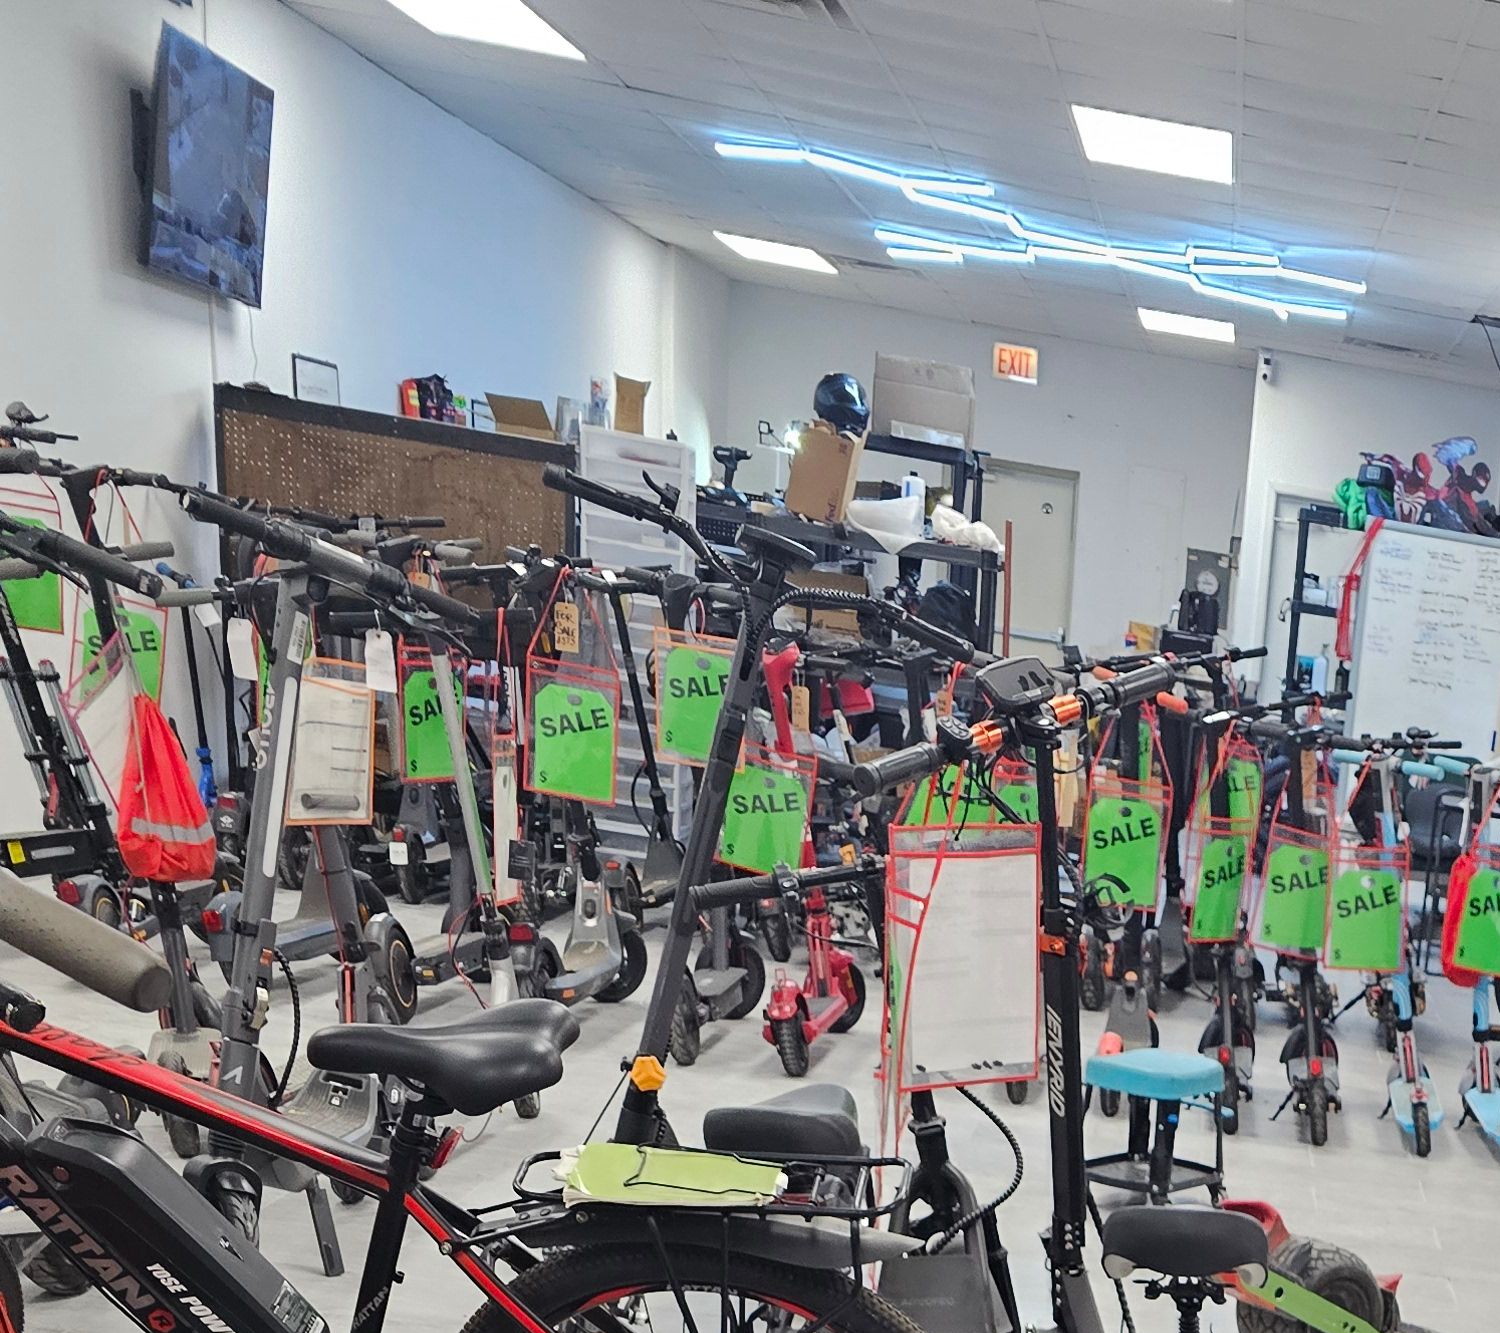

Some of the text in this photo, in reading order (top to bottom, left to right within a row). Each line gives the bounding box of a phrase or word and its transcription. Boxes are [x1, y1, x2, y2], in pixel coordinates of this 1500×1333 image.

[998, 348, 1032, 378] EXIT
[88, 630, 158, 656] SLE
[670, 674, 729, 699] SALE
[540, 708, 609, 738] SALE
[411, 760, 418, 773] $
[539, 770, 547, 784] $
[733, 791, 800, 815] SALE
[1093, 817, 1156, 850] SALE
[727, 843, 735, 855] $
[1204, 854, 1245, 889] SALE
[1271, 866, 1329, 895] SALE
[1336, 884, 1398, 919] SALE
[1047, 1004, 1066, 1118] IENYRID
[1, 1164, 155, 1309] RATTAN
[147, 1263, 188, 1294] YOSE
